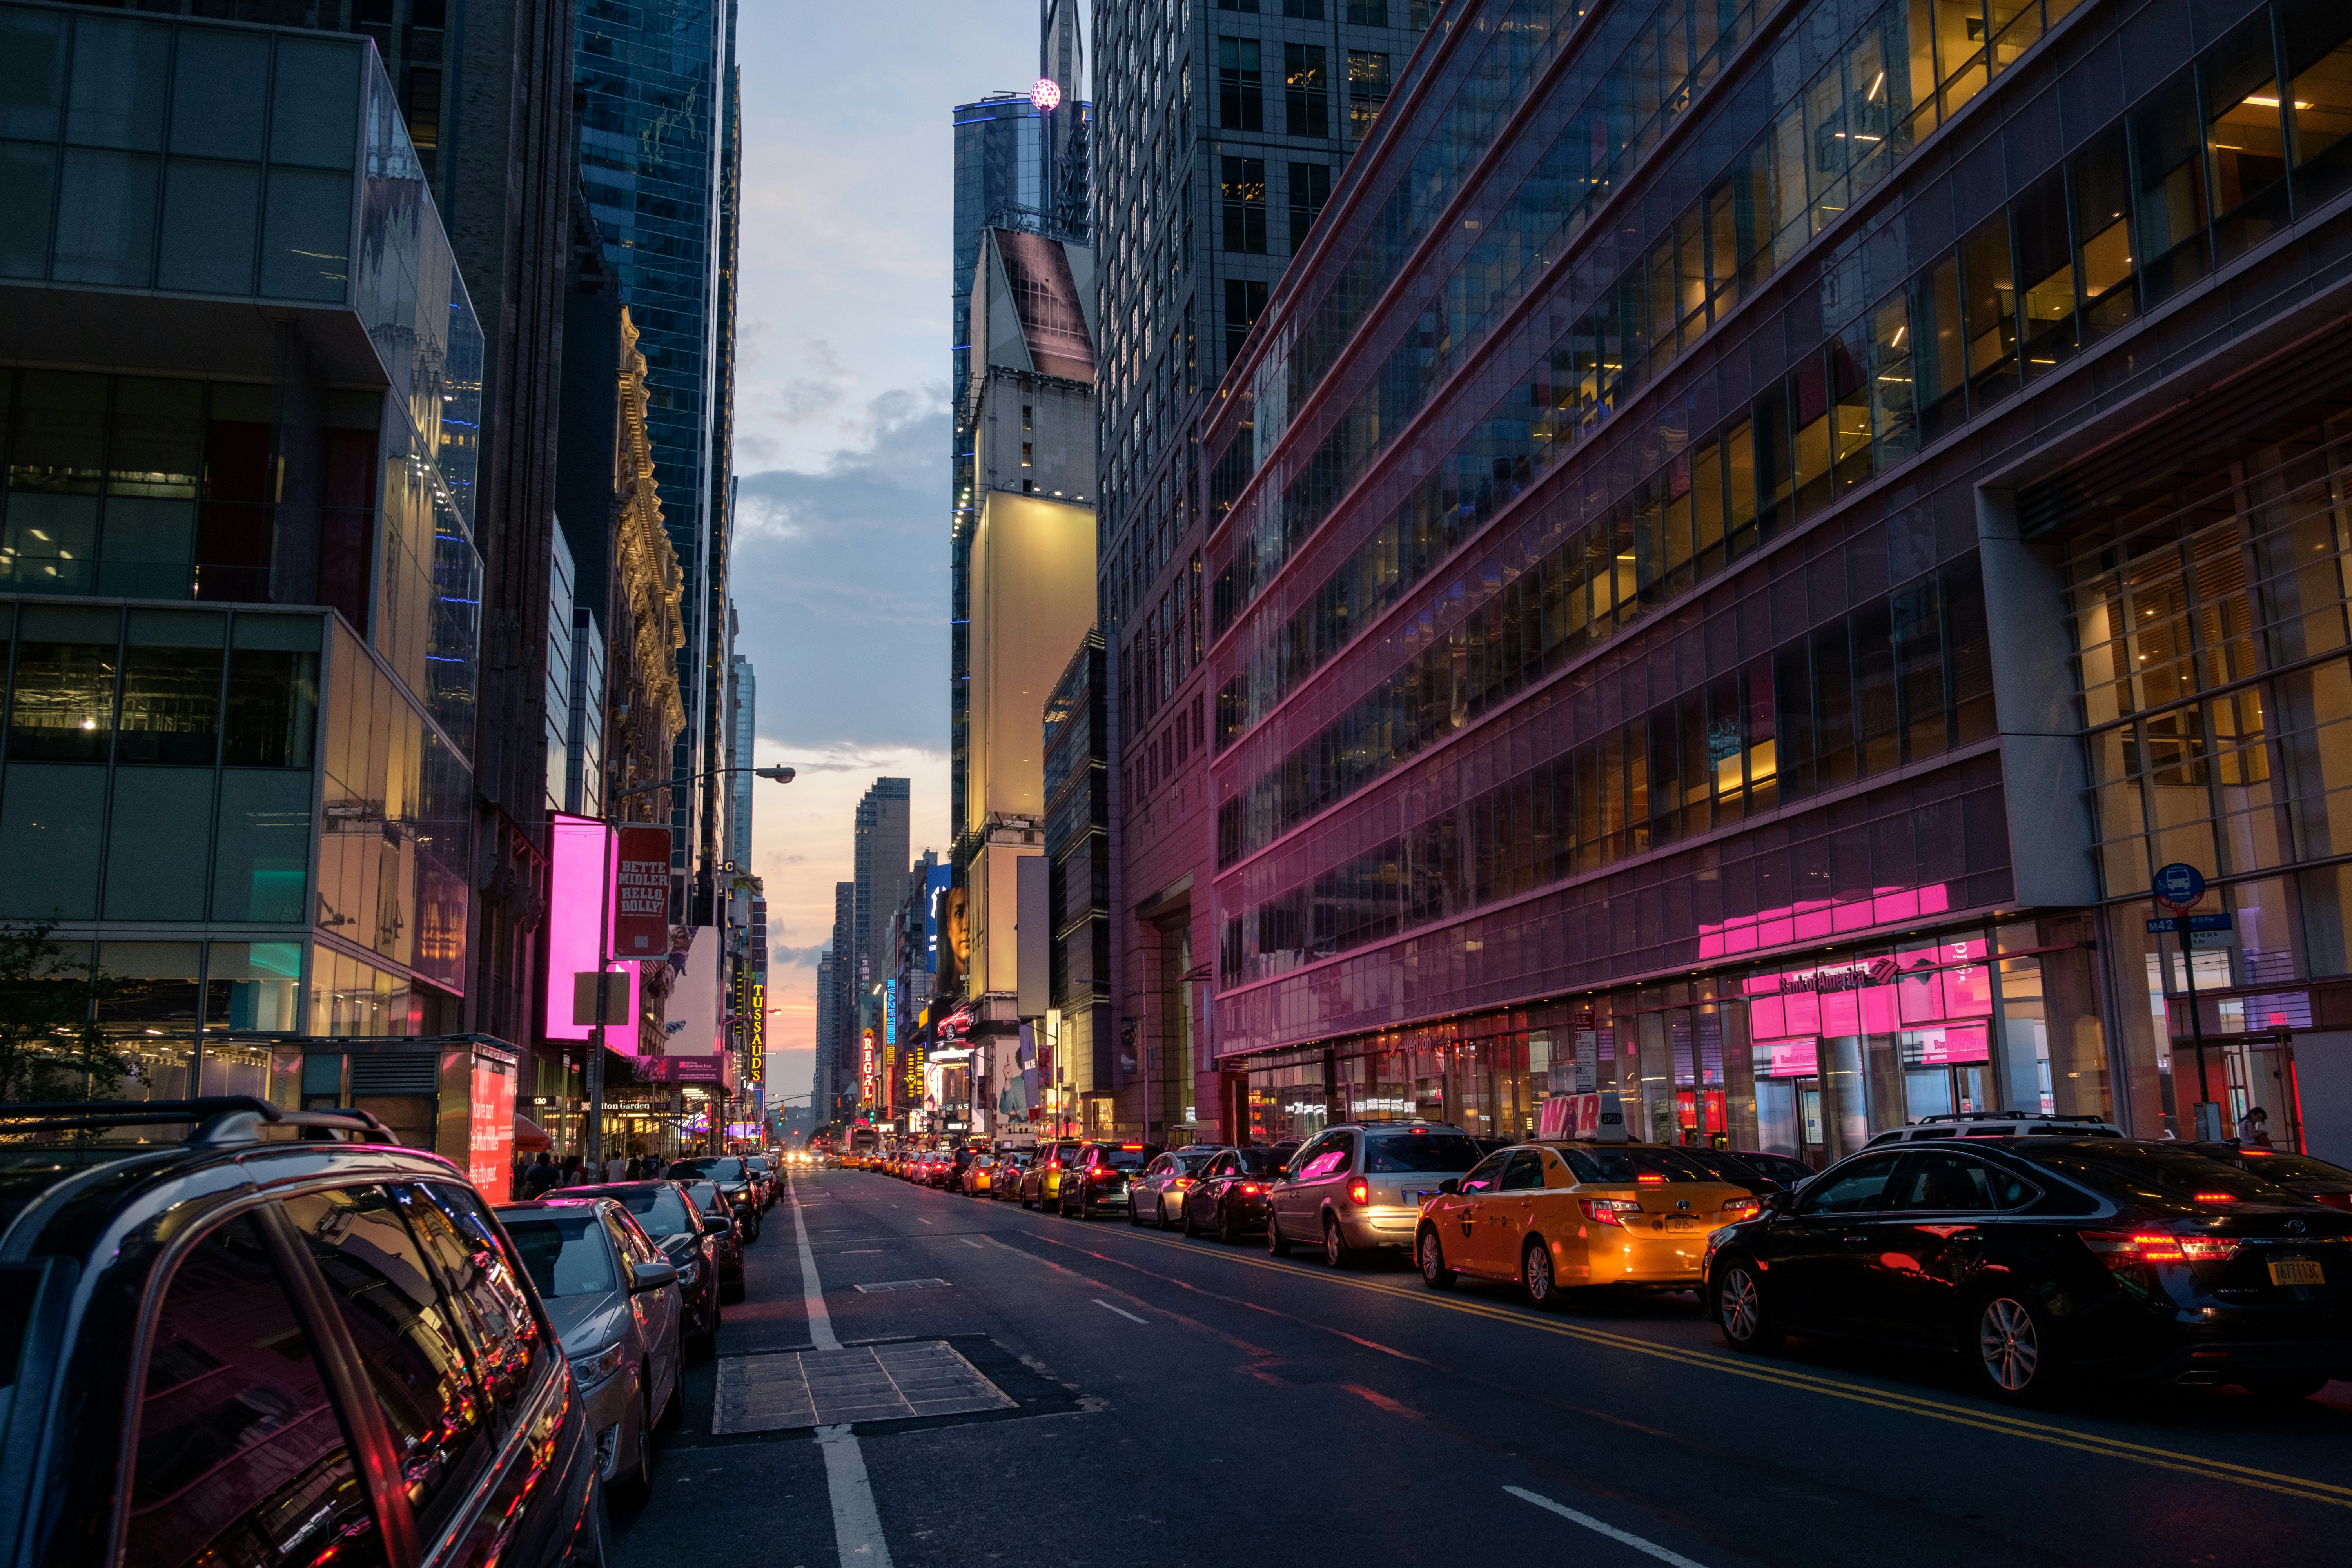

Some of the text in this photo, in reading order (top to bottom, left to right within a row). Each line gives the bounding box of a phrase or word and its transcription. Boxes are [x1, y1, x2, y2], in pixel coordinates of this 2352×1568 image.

[622, 860, 666, 873] BETTE
[618, 873, 668, 886] MIDLER
[622, 887, 665, 902] HELLO,
[2171, 895, 2200, 908] STANDING
[621, 900, 664, 913] DOLLY!
[2149, 920, 2174, 931] M42
[887, 979, 896, 993] NEW
[1779, 975, 1806, 995] Bank
[1806, 972, 1818, 992] of
[1818, 968, 1865, 991] America
[887, 993, 895, 1009] 42
[751, 985, 764, 1081] TUSSAUD'S
[887, 1017, 895, 1044] STUDIOS
[1405, 1035, 1451, 1055] verizon wireless
[1934, 1039, 1950, 1049] Bank
[1951, 1038, 1958, 1048] of
[863, 1038, 873, 1098] REGAL
[277, 1063, 289, 1110] Newsst
[473, 1098, 494, 1125] You're part
[471, 1129, 499, 1151] of what makes
[485, 1163, 497, 1189] great.
[2273, 1263, 2319, 1279] T677113C
